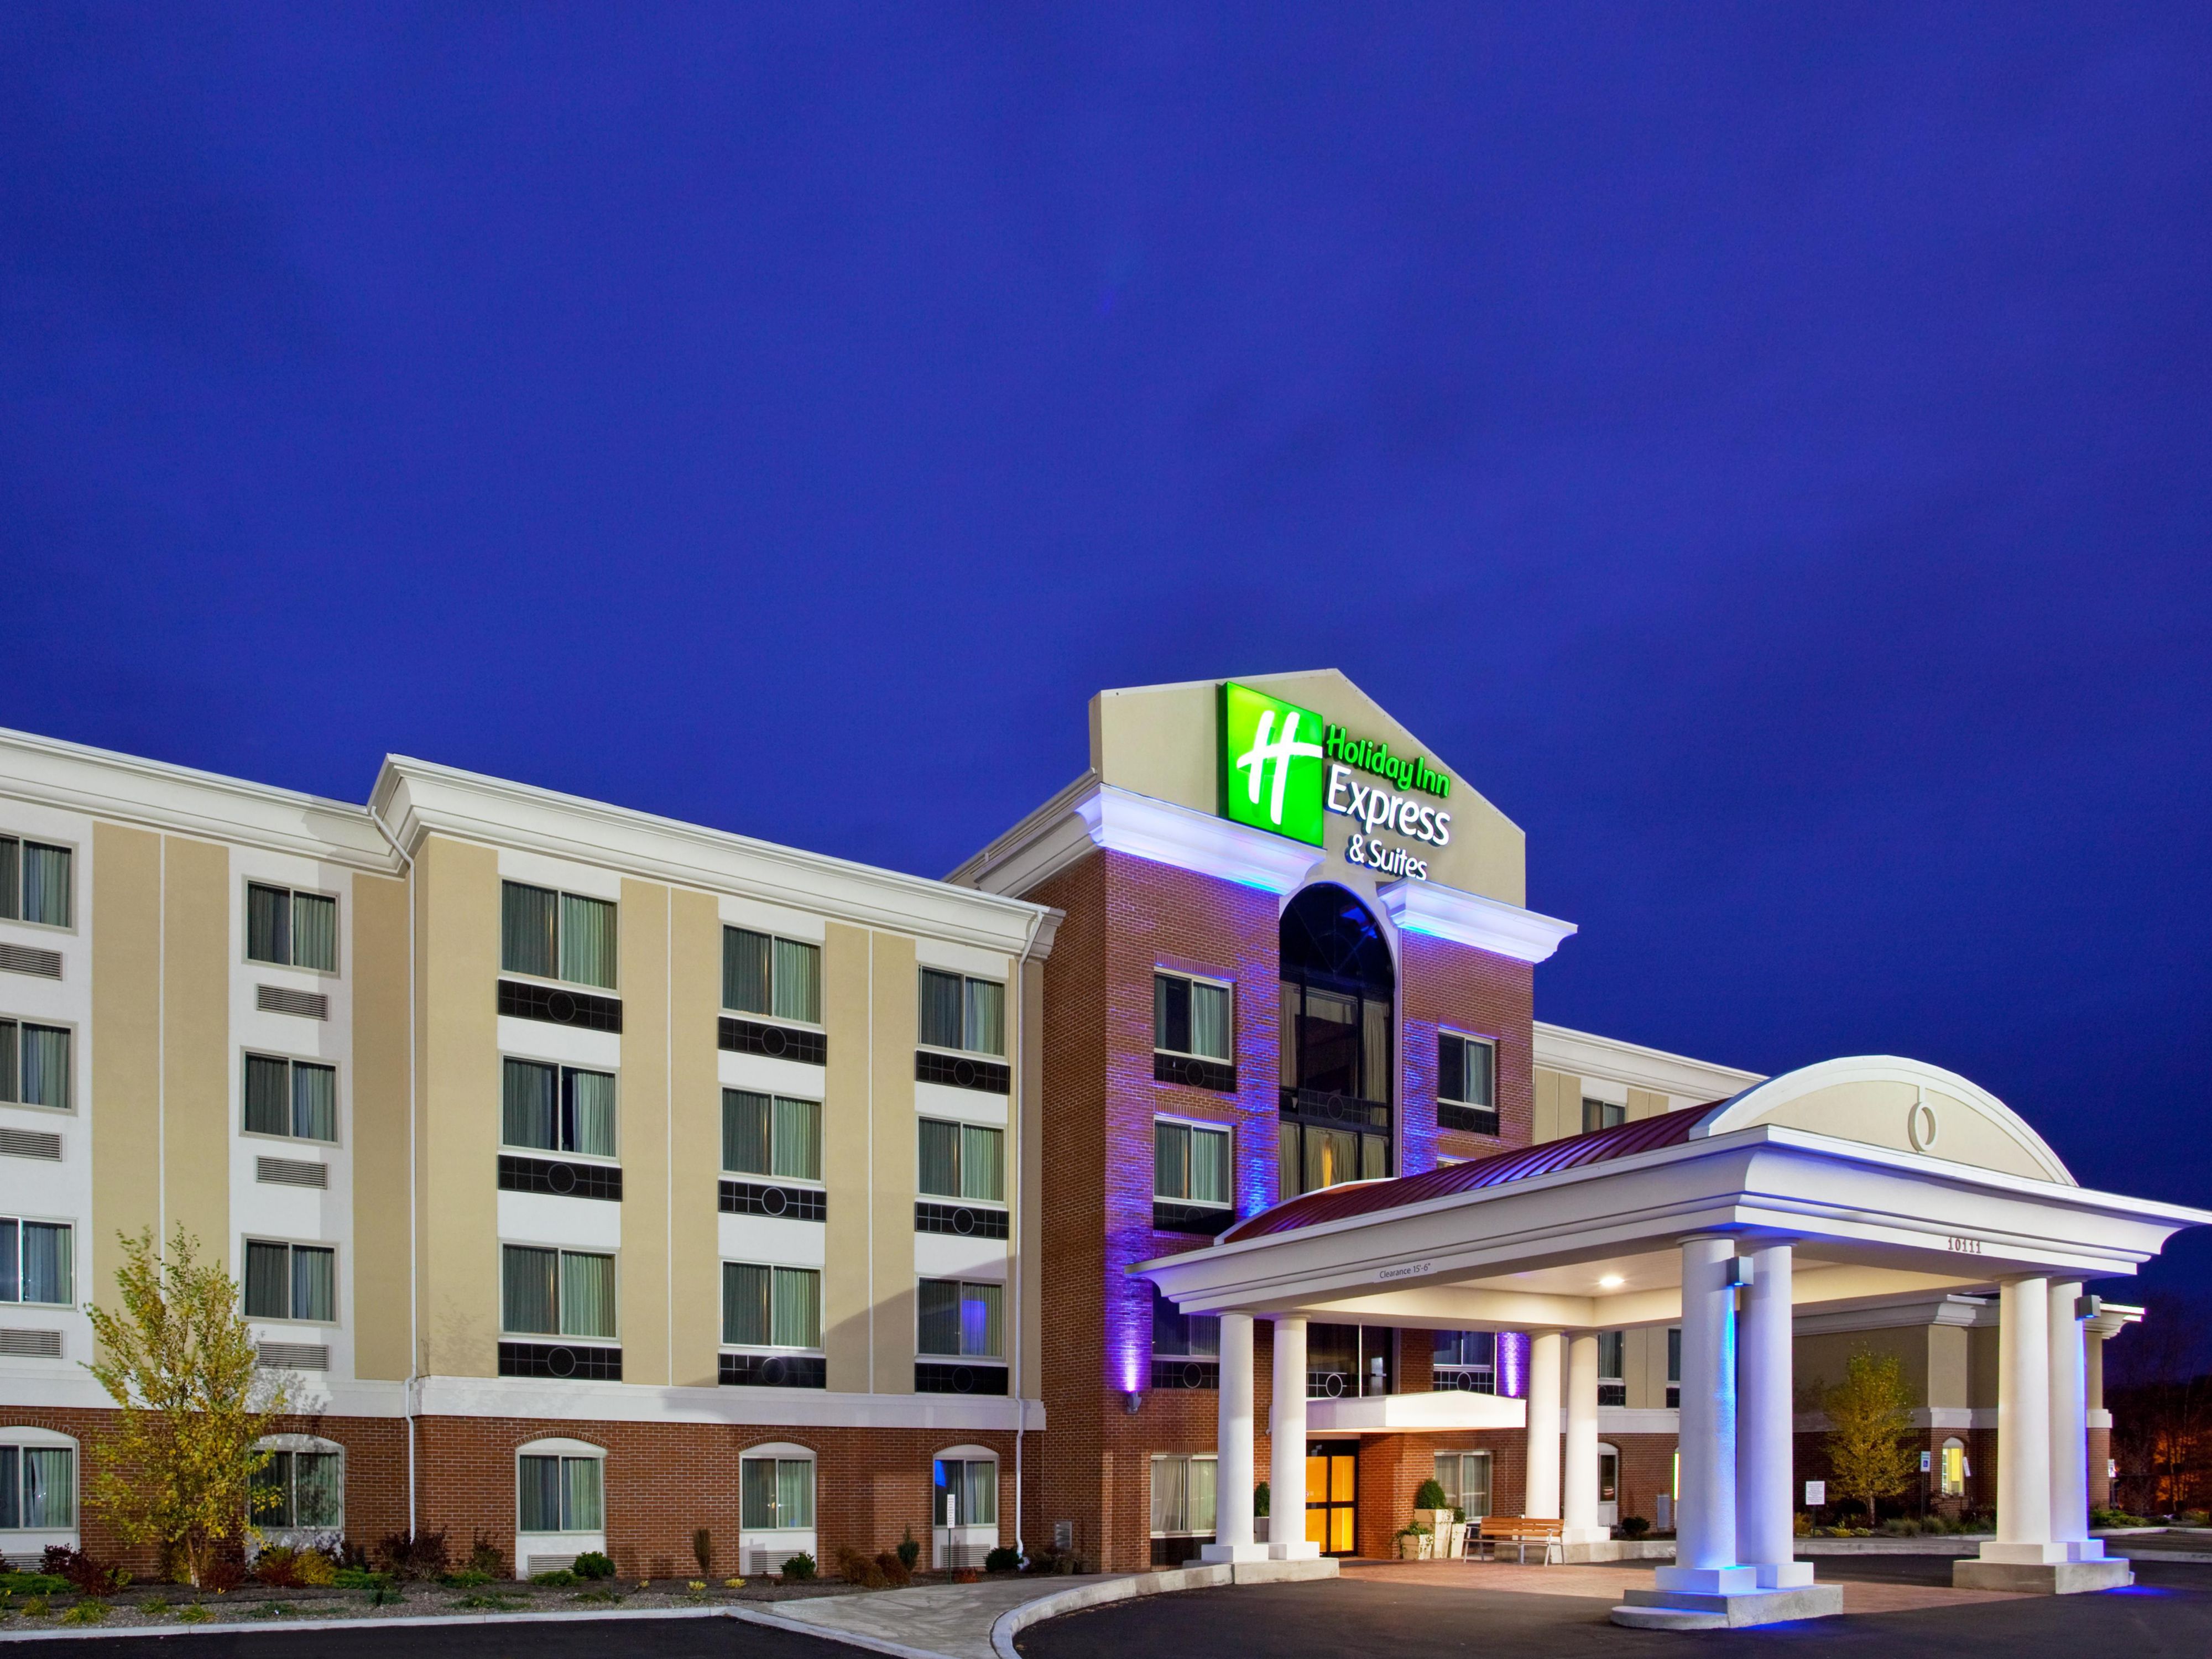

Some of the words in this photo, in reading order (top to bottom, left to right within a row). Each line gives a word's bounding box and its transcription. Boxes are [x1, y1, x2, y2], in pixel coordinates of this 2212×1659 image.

[1327, 723, 1414, 790] Holiday
[1416, 756, 1451, 798] Inn
[1327, 763, 1451, 846] Express
[1349, 833, 1365, 864] &
[1368, 839, 1428, 881] Suites
[1948, 1237, 1981, 1254] 10111
[1379, 1267, 1411, 1279] Clearance
